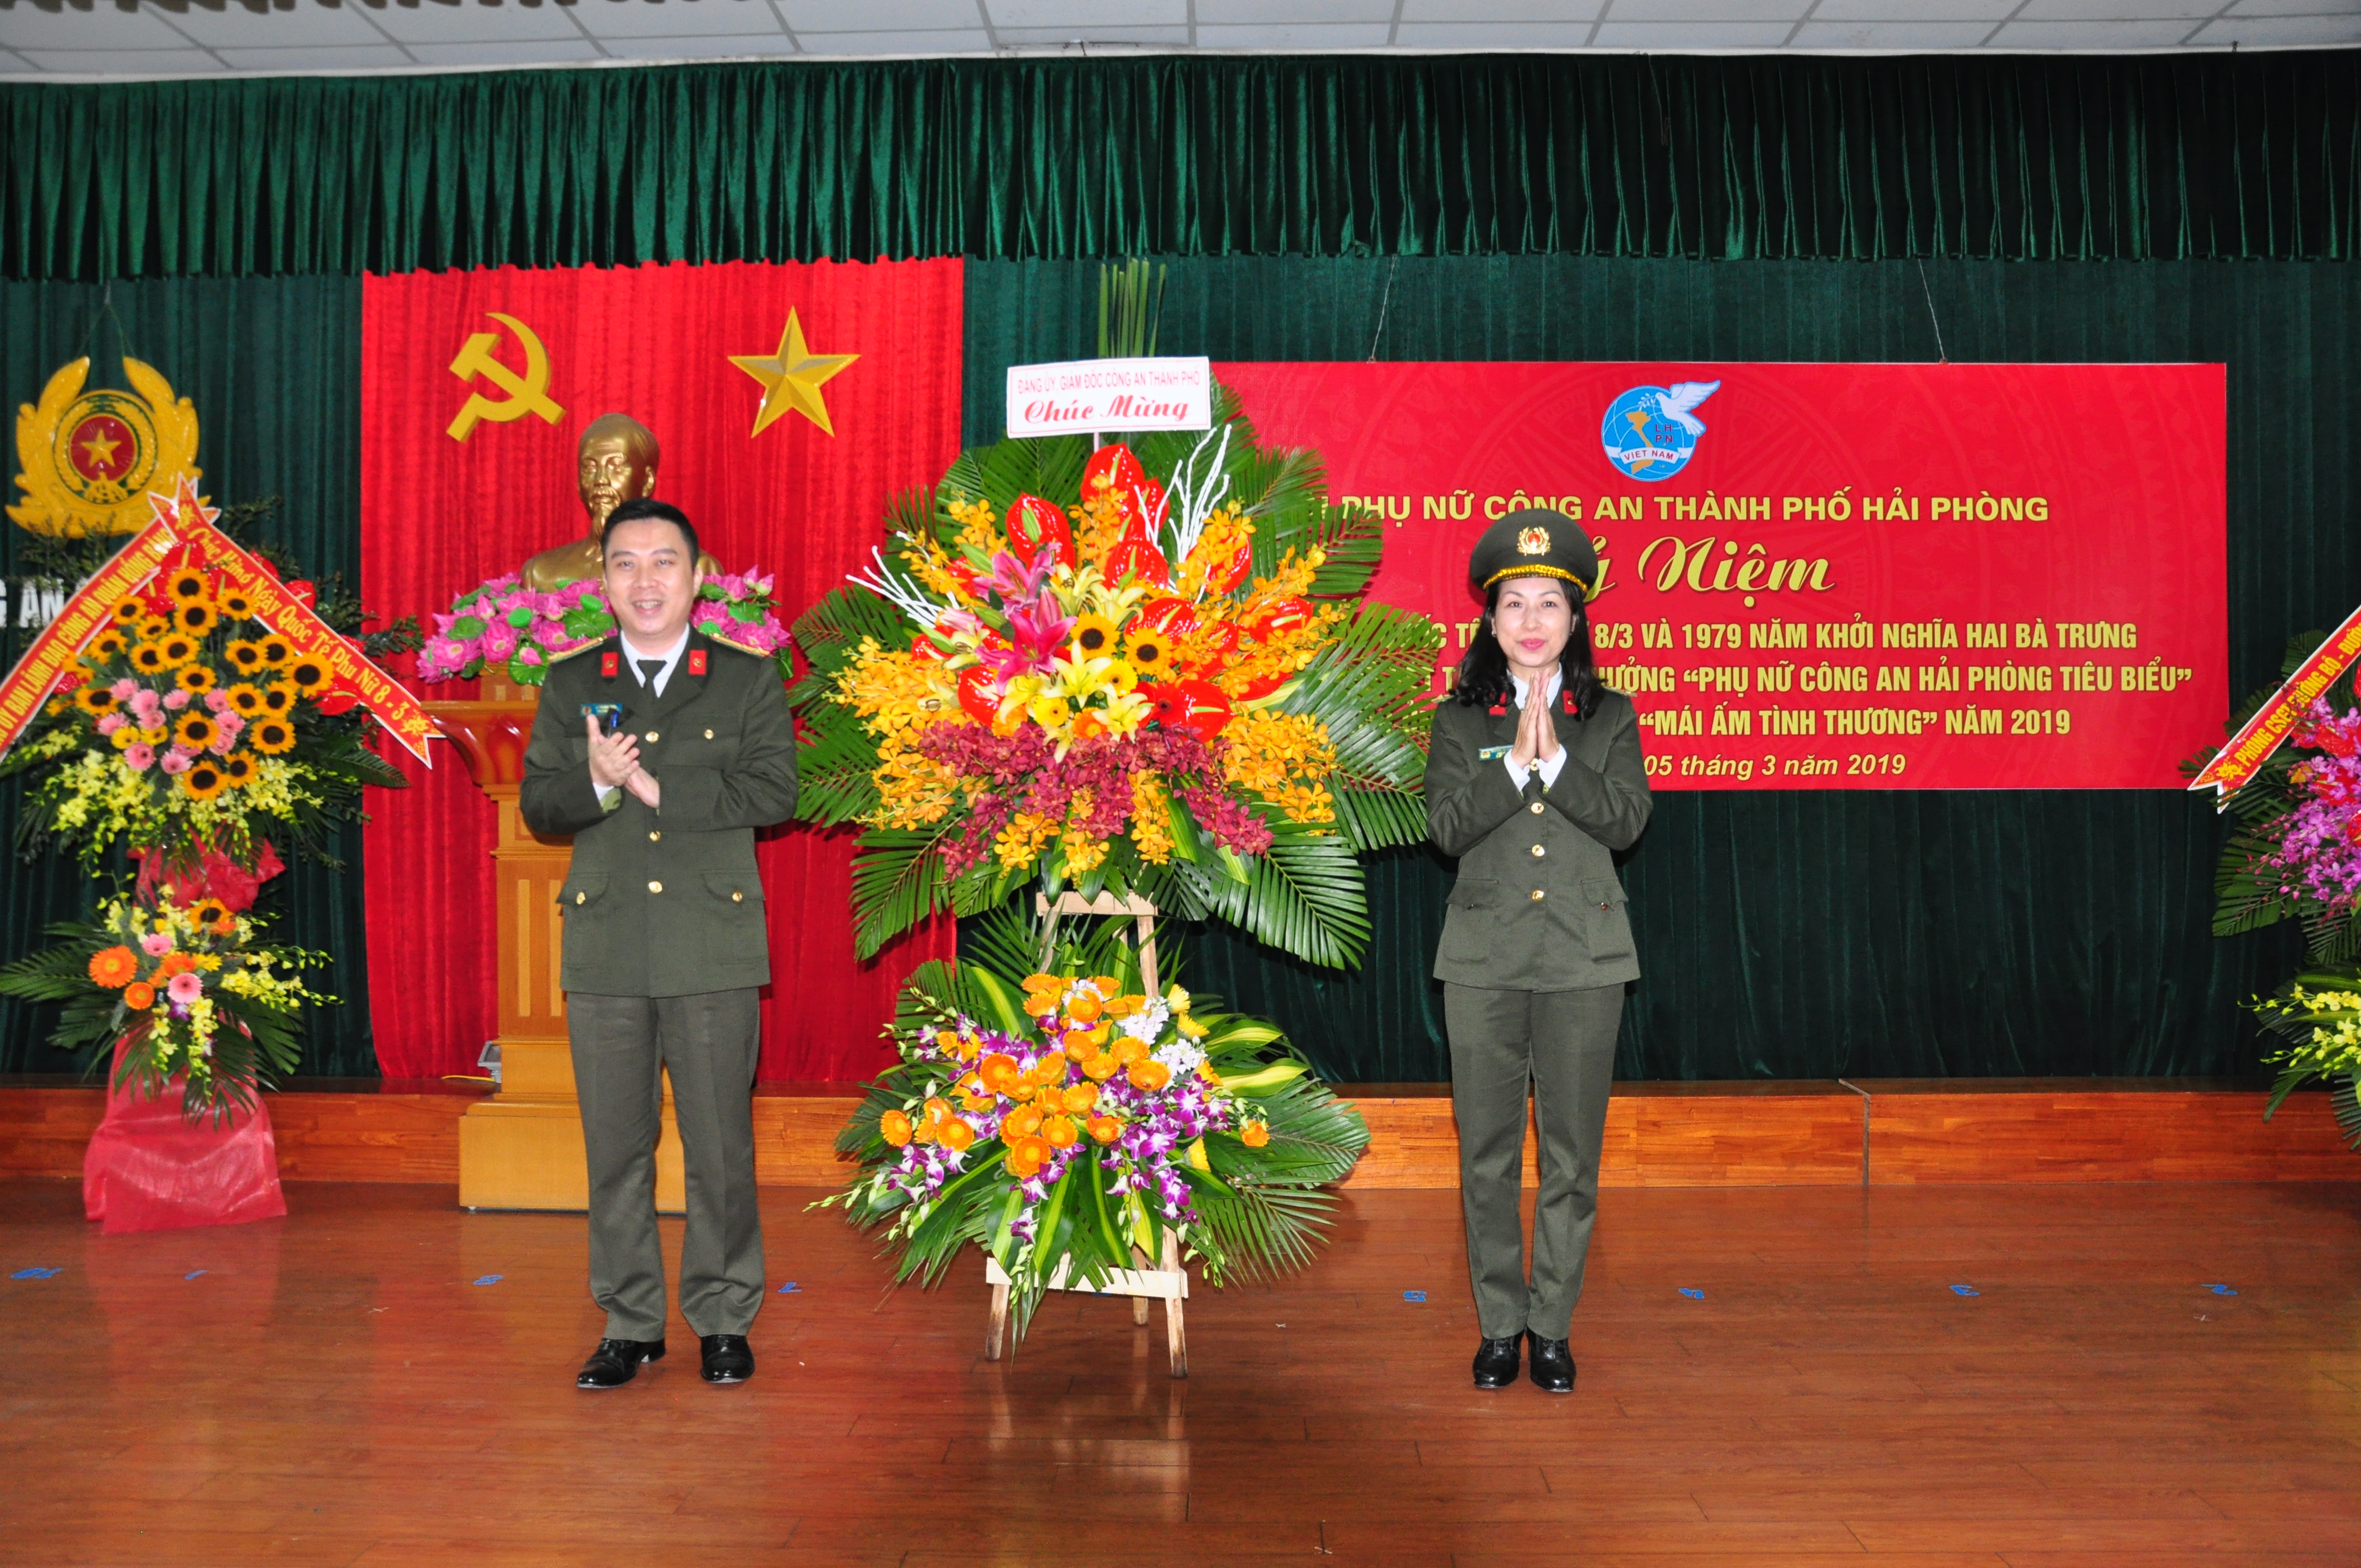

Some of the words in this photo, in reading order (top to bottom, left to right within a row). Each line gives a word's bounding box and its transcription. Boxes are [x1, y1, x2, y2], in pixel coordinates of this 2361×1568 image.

[1105, 368, 1131, 386] CÔNG
[1134, 371, 1146, 386] AN
[1025, 400, 1095, 424] Chúc
[1100, 395, 1189, 422] Mừng
[1624, 449, 1647, 460] VIET
[1652, 450, 1674, 460] NAM
[1424, 489, 1475, 520] NỮ
[1594, 497, 1642, 520] AN
[1654, 491, 1770, 520] THÀNH
[1783, 486, 1852, 521] PHỐ
[1863, 487, 1919, 520] HẢI
[1932, 491, 2048, 521] PHÒNG
[1638, 536, 1835, 607] Niệm
[1595, 623, 1633, 649] 8/3
[1641, 618, 1673, 648] VÀ
[1682, 623, 1741, 649] 1979
[1750, 618, 1807, 648] NĂM
[1816, 612, 1873, 649] KHỞI
[1883, 618, 1959, 648] NGHĨA
[1967, 623, 2007, 648] HAI
[2016, 618, 2048, 648] BÀ
[2056, 620, 2136, 649] TRƯNG
[3, 685, 36, 716] BAN
[79, 596, 106, 620] AN
[276, 605, 315, 643] Quốc
[373, 684, 391, 704] 8
[391, 700, 411, 720] 3
[1757, 660, 1795, 692] NỮ
[1800, 661, 1868, 692] CÔNG
[1876, 666, 1910, 691] AN
[1919, 655, 1959, 691] HẢI
[1968, 660, 2052, 692] PHÒNG
[2059, 661, 2112, 692] TIÊU
[1711, 701, 1750, 735] ẤM
[1759, 705, 1815, 735] TÌNH
[1945, 704, 2003, 734] NĂM
[2011, 709, 2070, 734] 2019
[2234, 727, 2276, 767] PHÒNG
[2318, 655, 2343, 677] BỘ
[1644, 755, 1673, 776] 05
[1681, 754, 1754, 781] tháng
[1761, 755, 1776, 775] 3
[1783, 754, 1838, 775] năm
[1847, 754, 1906, 775] 2019
